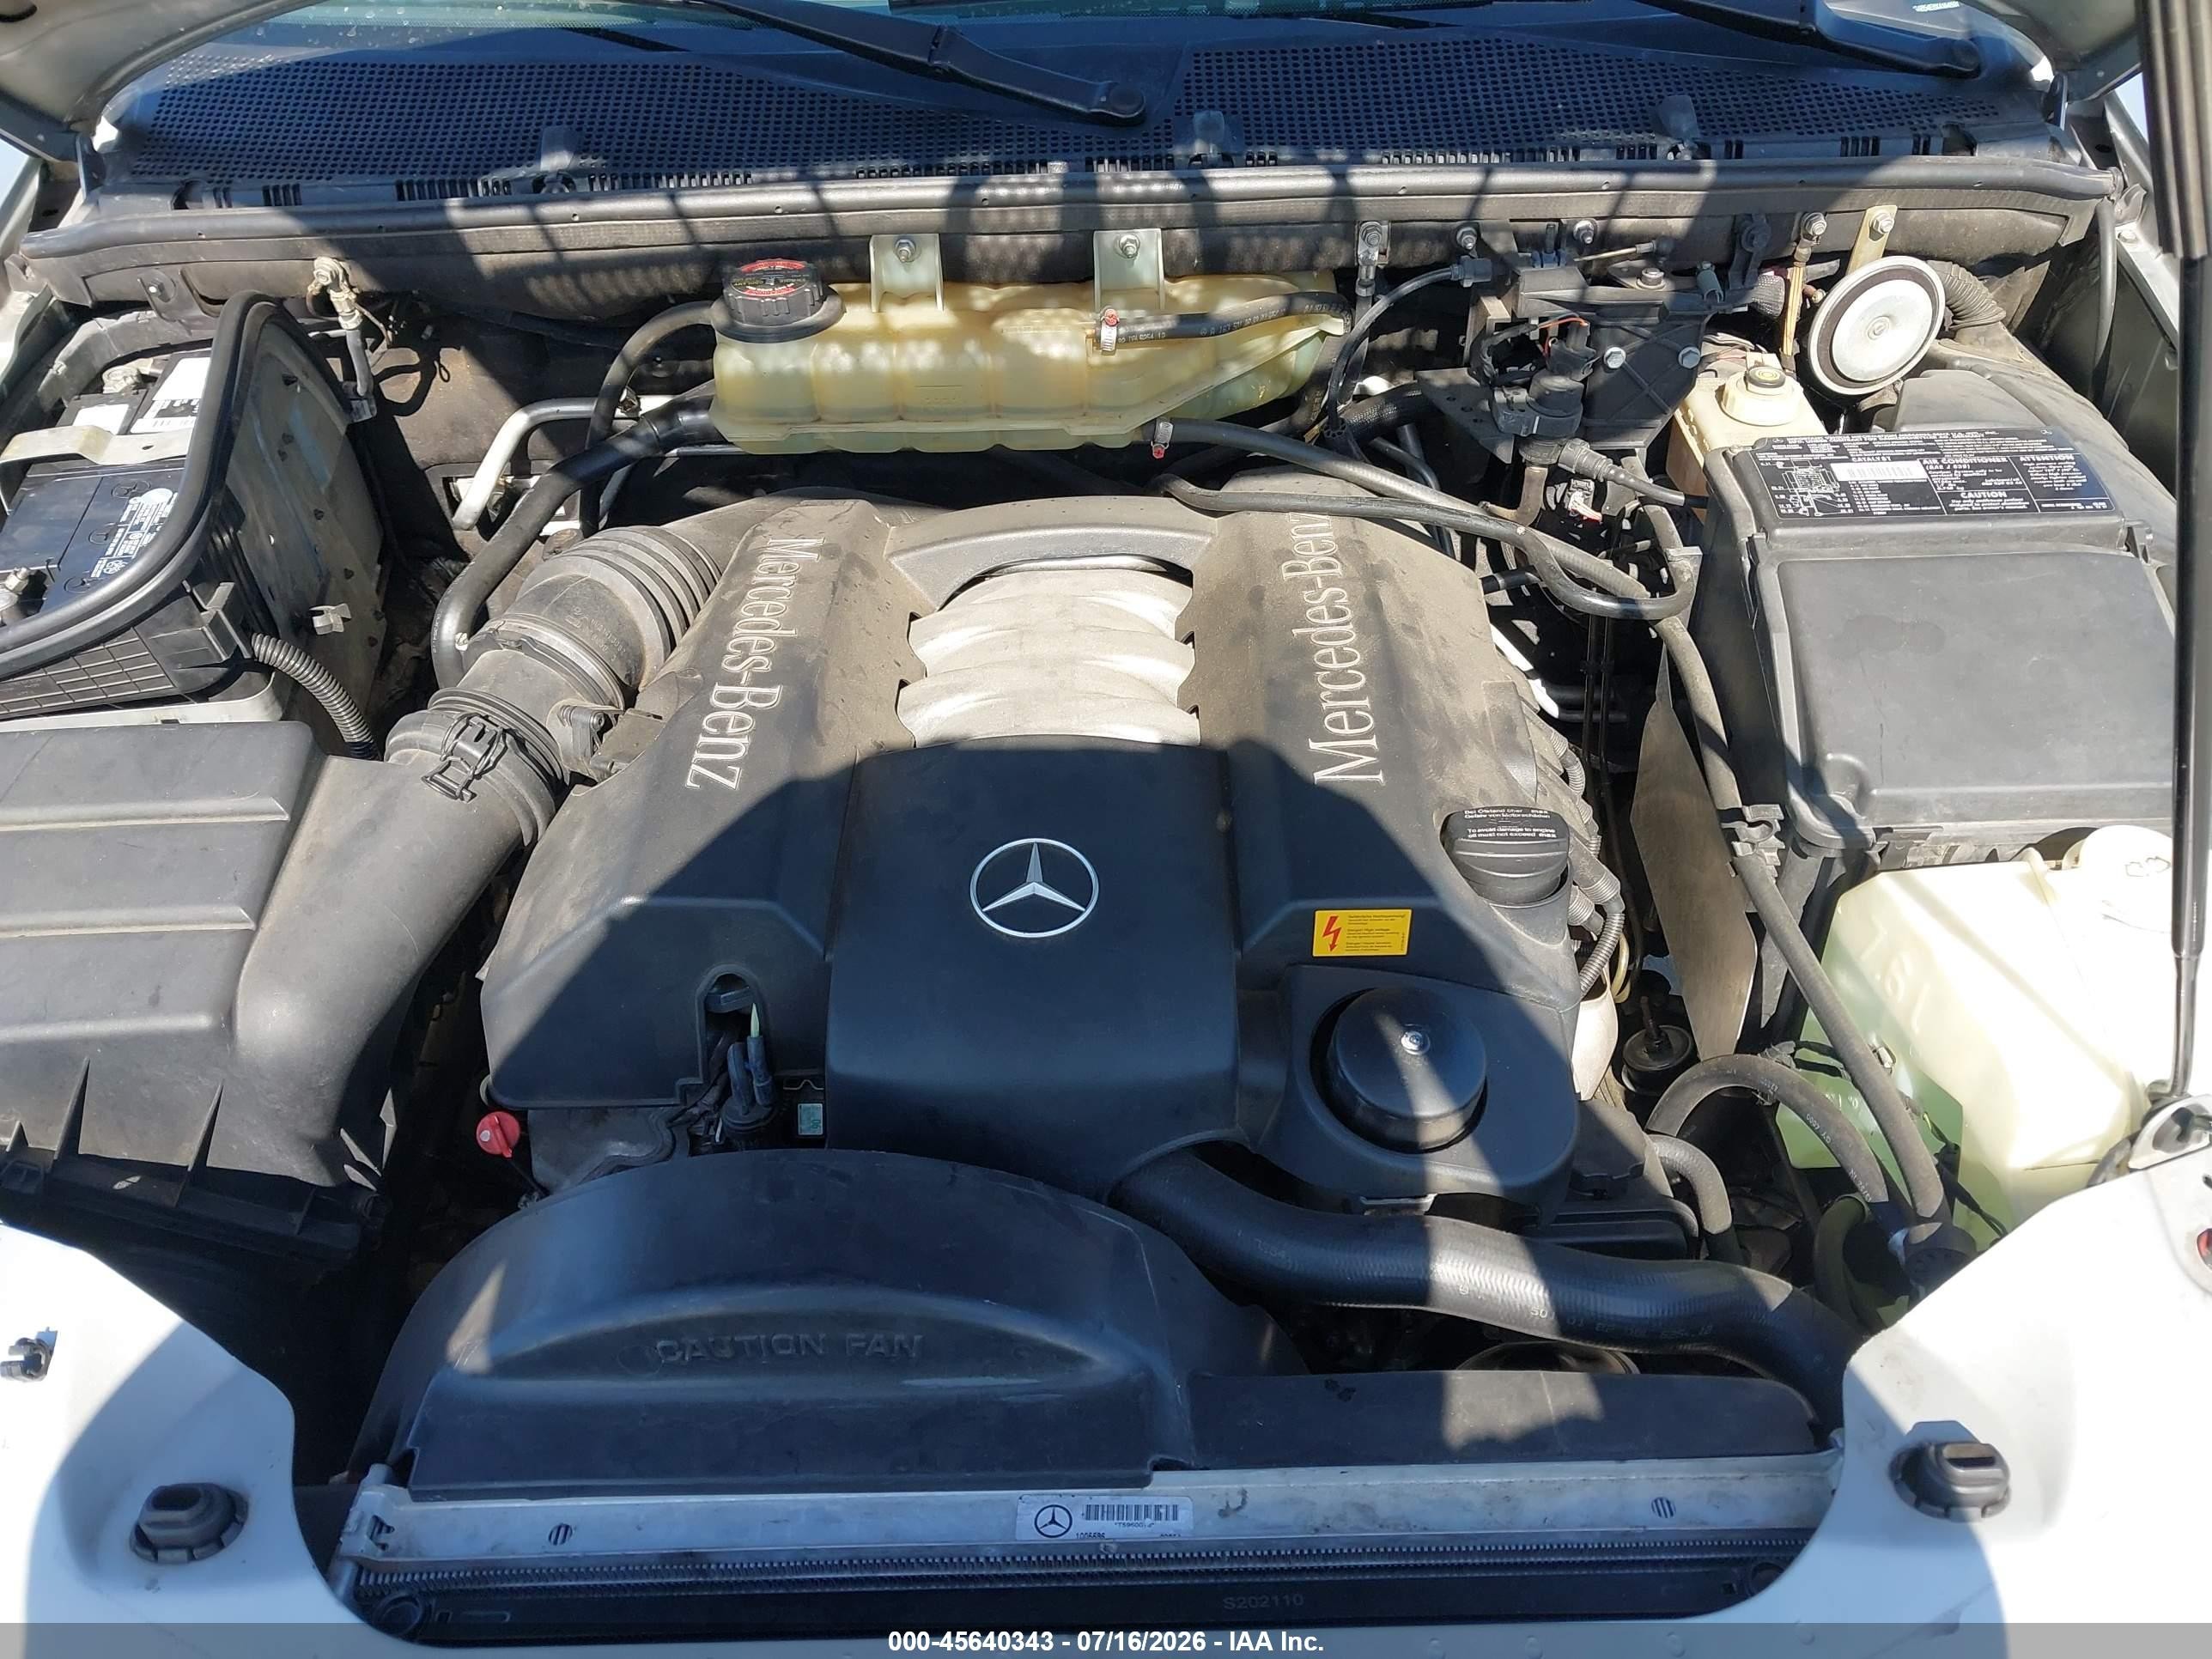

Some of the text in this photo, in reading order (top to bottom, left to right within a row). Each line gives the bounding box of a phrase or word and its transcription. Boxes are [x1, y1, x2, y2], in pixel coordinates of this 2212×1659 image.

[686, 537, 826, 792] Mercedes-Benz
[656, 1334, 923, 1362] CAUTION FAN
[1223, 1593, 1305, 1610] S202110
